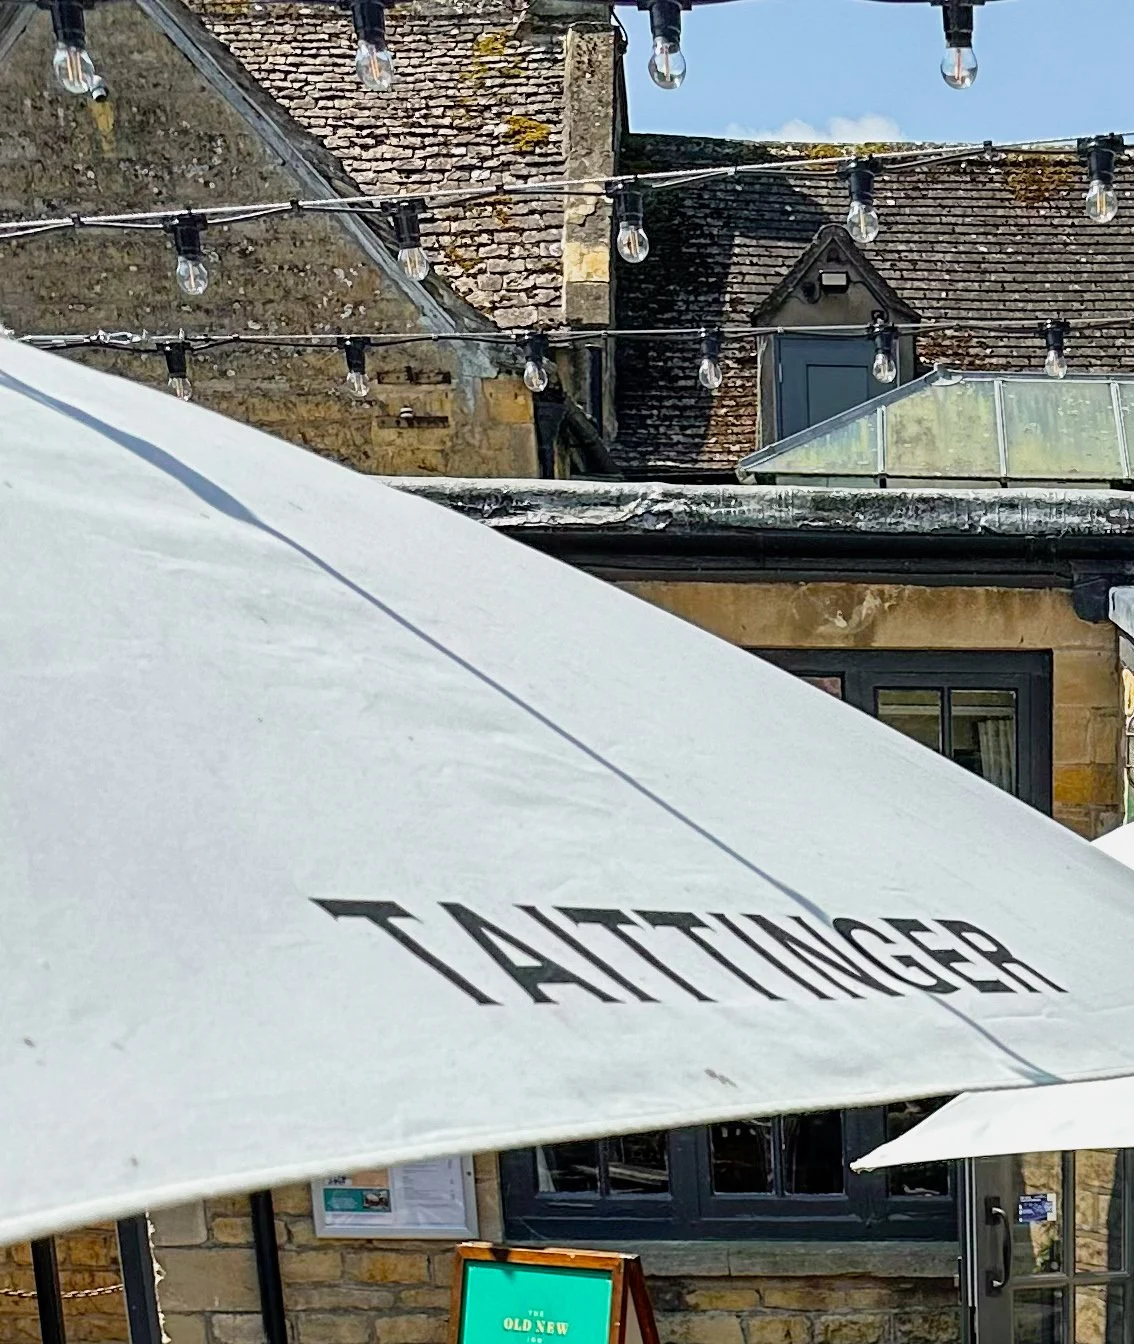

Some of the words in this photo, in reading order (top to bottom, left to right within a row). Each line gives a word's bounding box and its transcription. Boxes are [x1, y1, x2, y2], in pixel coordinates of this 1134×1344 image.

[307, 896, 1070, 1007] TAITTINGER
[503, 1317, 532, 1332] OLD
[535, 1319, 569, 1335] NEW
